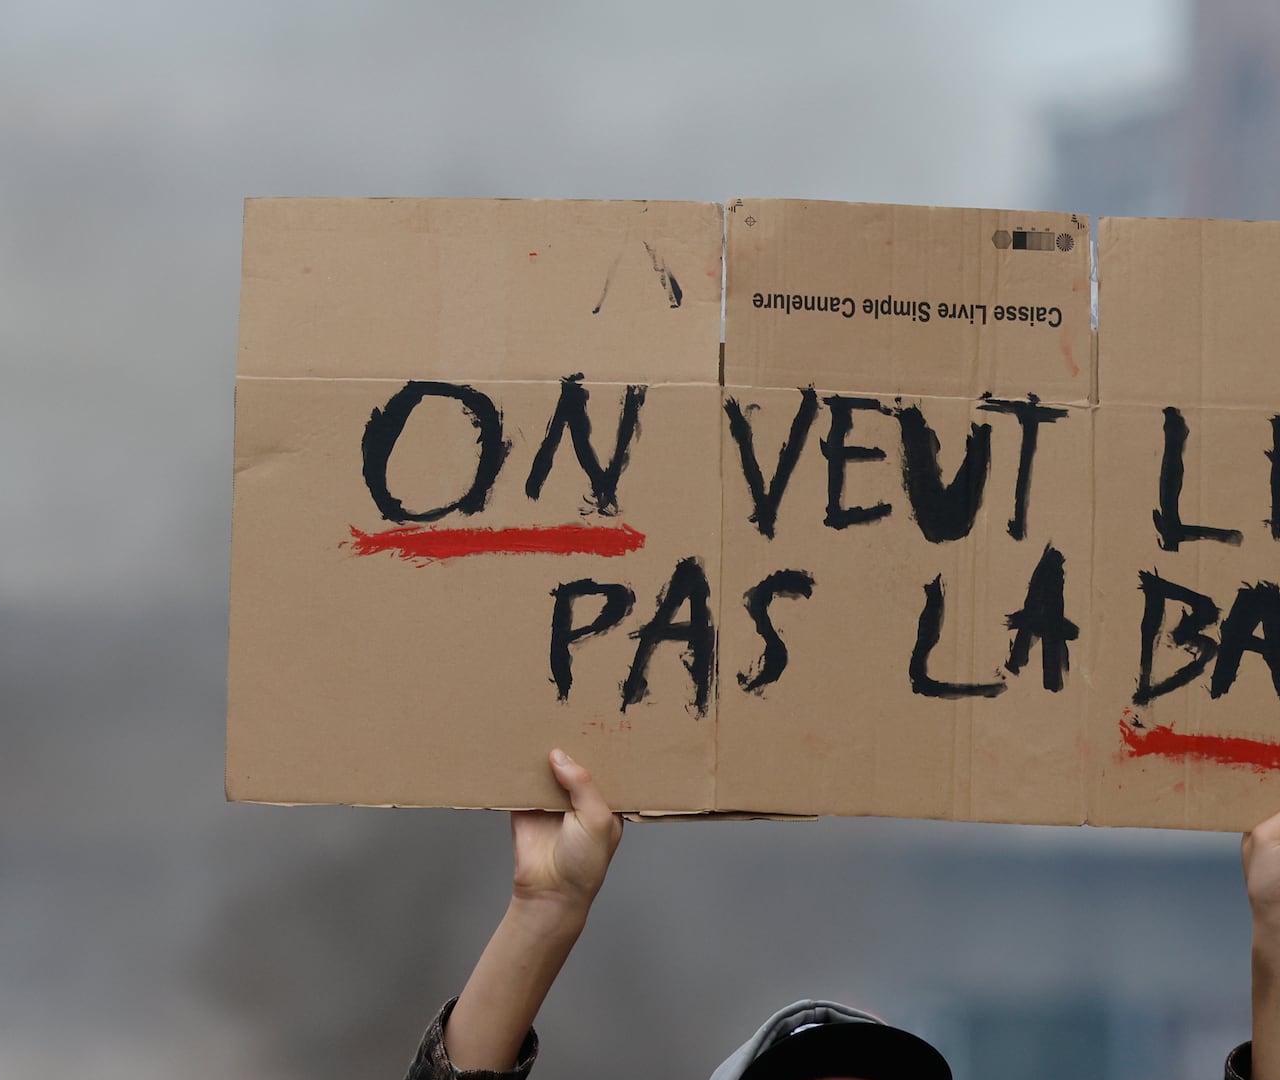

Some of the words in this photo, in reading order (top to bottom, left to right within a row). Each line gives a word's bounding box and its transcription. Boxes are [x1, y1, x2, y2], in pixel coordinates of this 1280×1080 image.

[752, 292, 856, 319] Cannelure
[862, 294, 931, 323] Simple
[937, 302, 987, 326] Livre
[993, 305, 1063, 328] Caisse
[361, 373, 649, 525] ON
[723, 384, 1070, 544] VEUT
[549, 557, 817, 719] PAS
[909, 542, 1080, 700] LA
